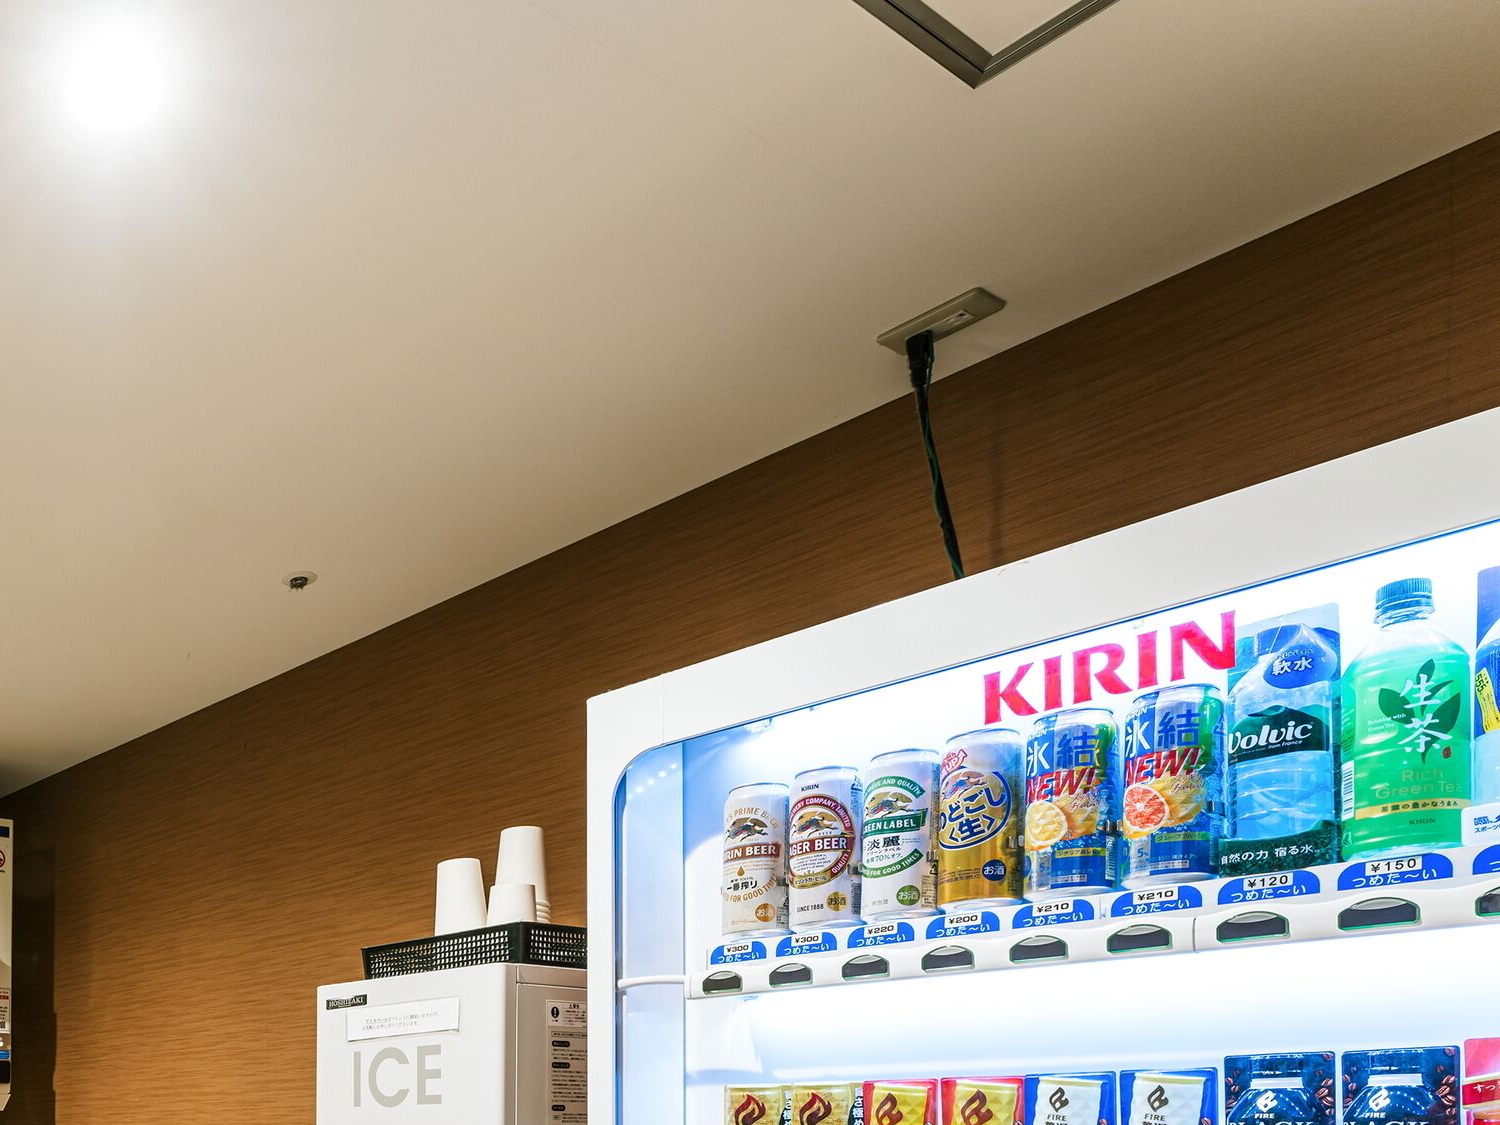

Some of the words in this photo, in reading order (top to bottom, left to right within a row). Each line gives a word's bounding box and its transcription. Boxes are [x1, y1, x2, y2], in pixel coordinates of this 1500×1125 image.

[984, 610, 1236, 725] KIRIN
[1271, 656, 1313, 676] 軟水
[1398, 673, 1453, 754] 生茶
[1125, 709, 1200, 759] 氷結
[1228, 720, 1314, 755] Volvic
[1027, 731, 1097, 778] 氷結
[801, 783, 820, 793] KIRIN
[1374, 782, 1434, 800] Green
[734, 807, 759, 819] PRIME
[836, 804, 851, 828] LIMITED
[884, 817, 917, 830] LABEL
[1408, 816, 1436, 826] KIRIN
[745, 844, 777, 857] BEER
[814, 837, 848, 852] BEER
[1220, 848, 1269, 866] 自然の力
[882, 864, 902, 876] GOOD
[1371, 858, 1417, 874] ¥150
[1247, 875, 1289, 889] ¥120
[1137, 890, 1174, 901] ¥210
[1036, 902, 1070, 913] ¥210
[948, 915, 979, 925] ¥200
[867, 925, 895, 935] ¥220
[794, 935, 820, 944] ¥300
[726, 945, 749, 954] ¥300
[328, 996, 364, 1008] HOSHIZAKI
[353, 1044, 442, 1108] ICE
